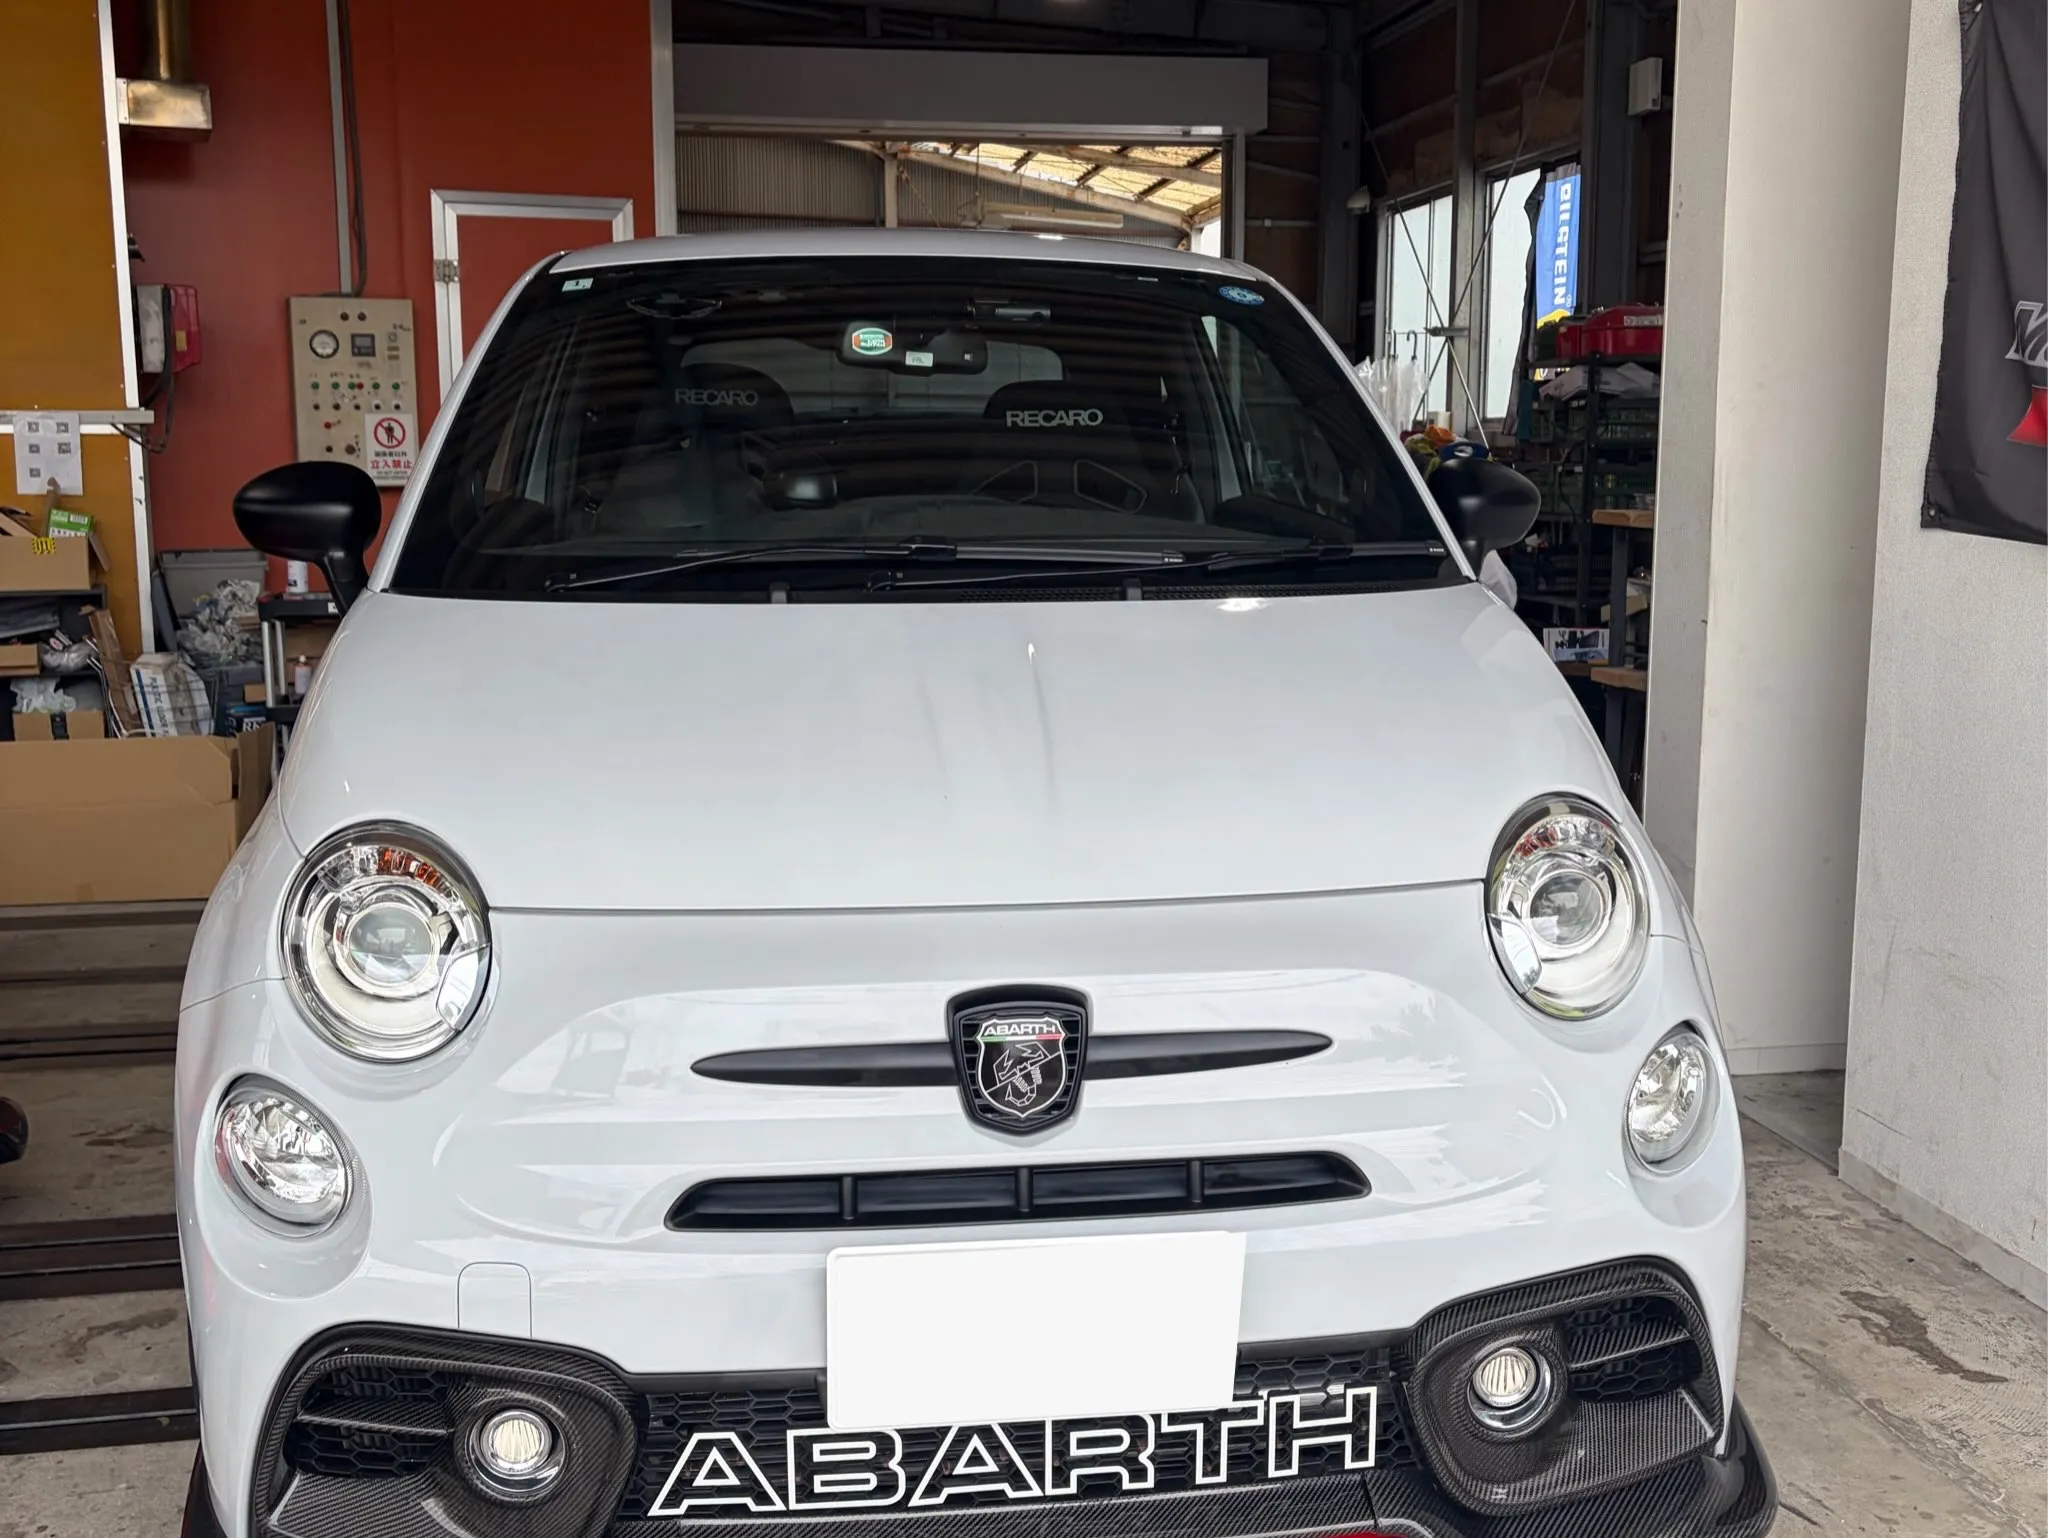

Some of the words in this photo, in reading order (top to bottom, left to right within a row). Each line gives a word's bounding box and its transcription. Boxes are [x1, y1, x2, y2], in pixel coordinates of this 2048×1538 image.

[674, 388, 759, 407] RECARO
[1005, 408, 1104, 428] RECARO
[370, 459, 413, 470] 立入禁止
[984, 1023, 1056, 1036] ABARTH
[647, 1386, 1377, 1517] ABARTH
